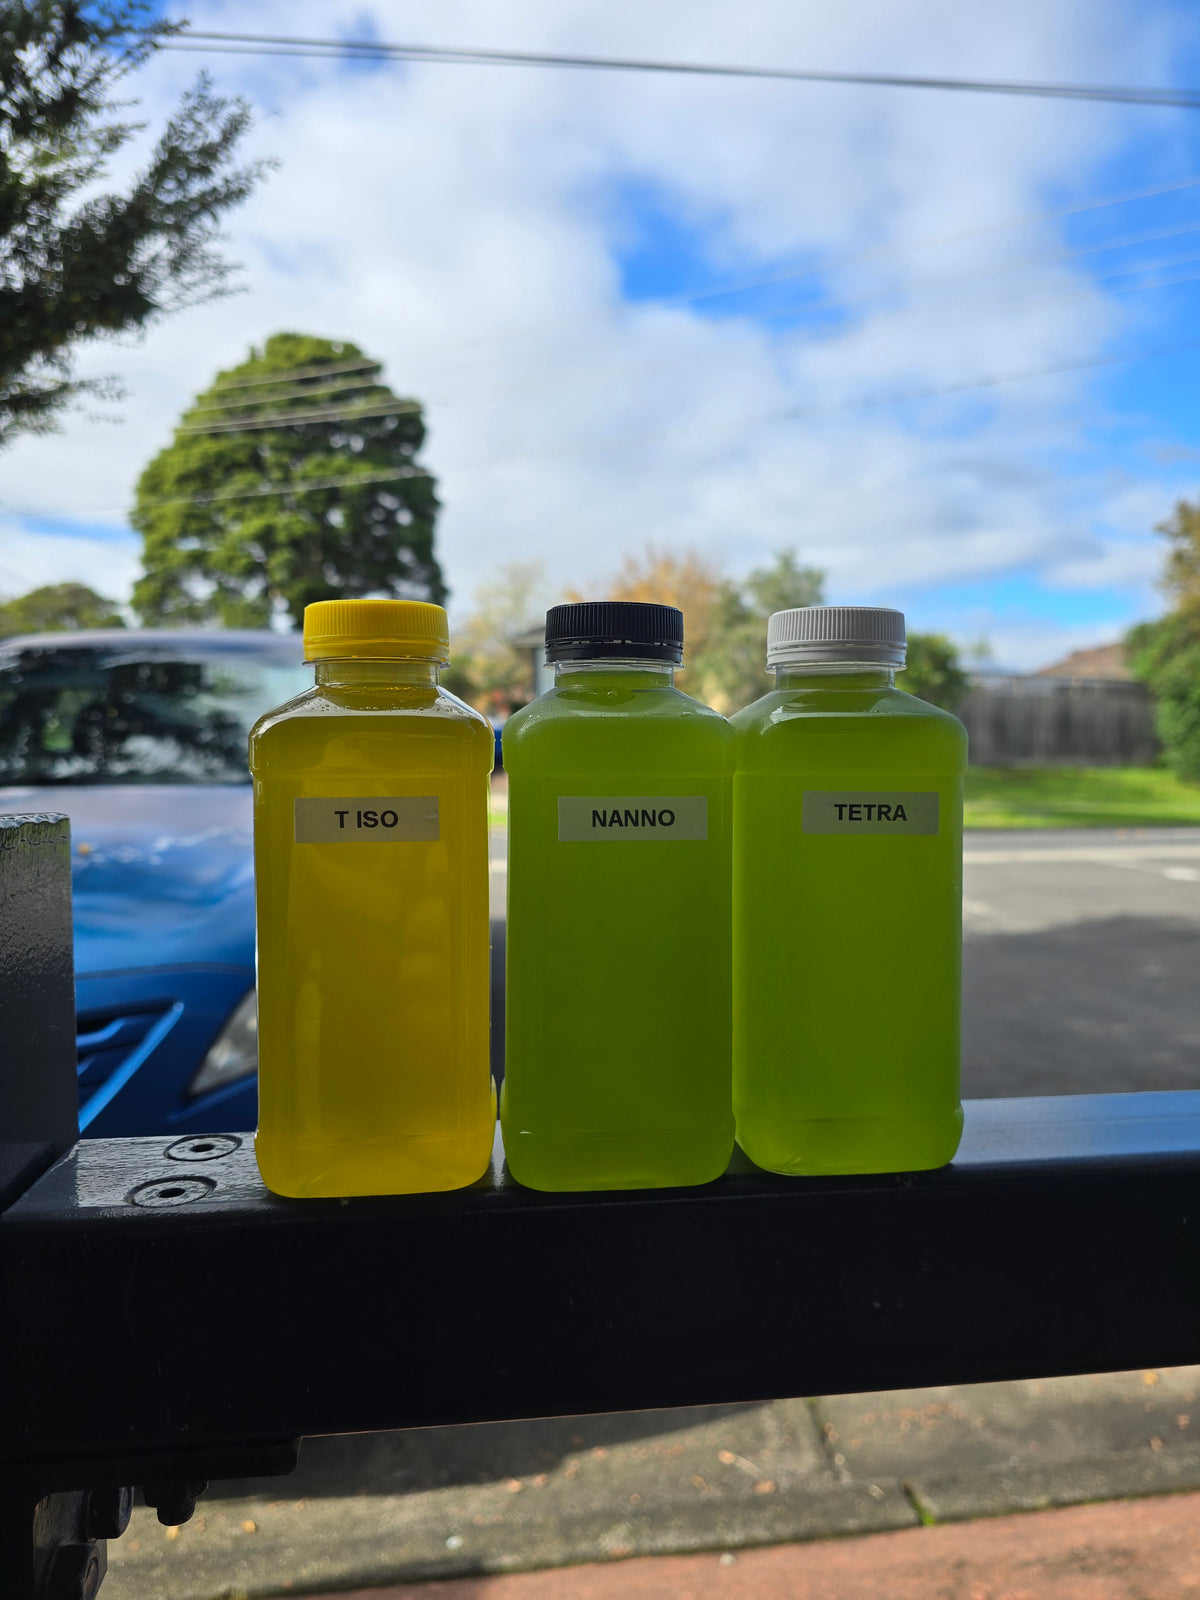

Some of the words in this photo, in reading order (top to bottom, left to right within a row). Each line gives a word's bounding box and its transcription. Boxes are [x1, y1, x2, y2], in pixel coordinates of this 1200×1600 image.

[334, 810, 350, 829] T
[356, 809, 399, 829] ISO
[591, 809, 676, 828] NANNO
[833, 803, 908, 822] TETRA
